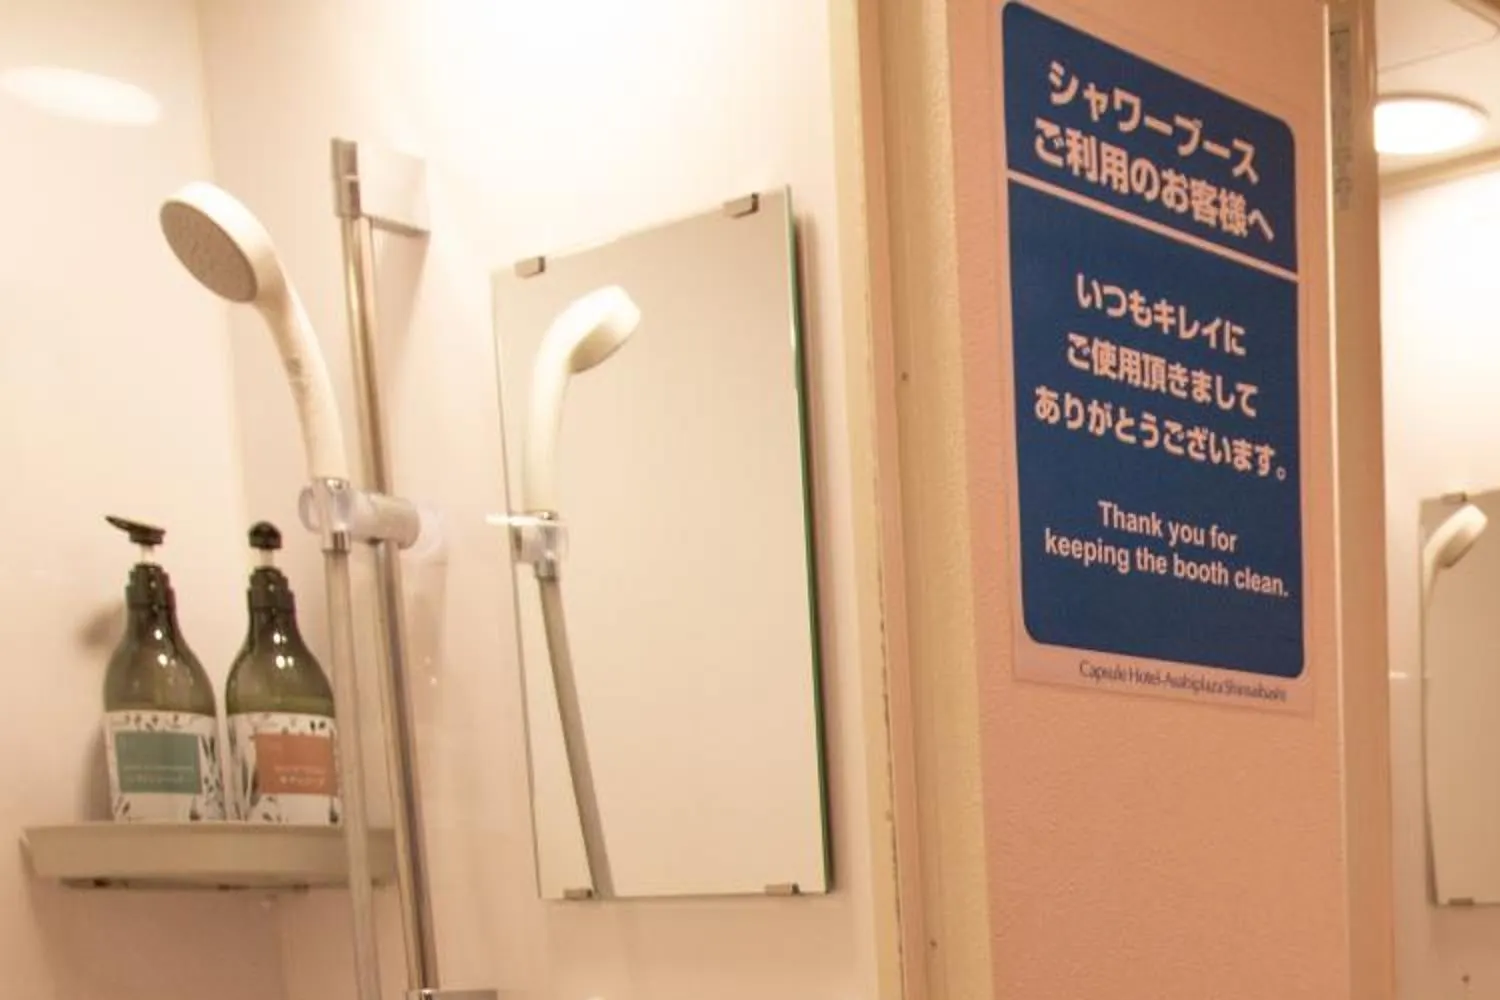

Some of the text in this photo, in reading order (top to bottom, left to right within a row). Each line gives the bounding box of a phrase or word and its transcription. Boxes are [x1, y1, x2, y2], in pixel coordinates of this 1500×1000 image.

[1048, 60, 1260, 185] シャワーブース
[1034, 116, 1275, 241] ご利用のお客様へ
[1076, 272, 1248, 356] いつもキレイに
[1066, 332, 1259, 418] ご使用頂きまして
[1034, 385, 1287, 481] ありがとうございます。
[1044, 527, 1290, 598] keeping the booth clean.
[1098, 499, 1239, 553] Thank you for
